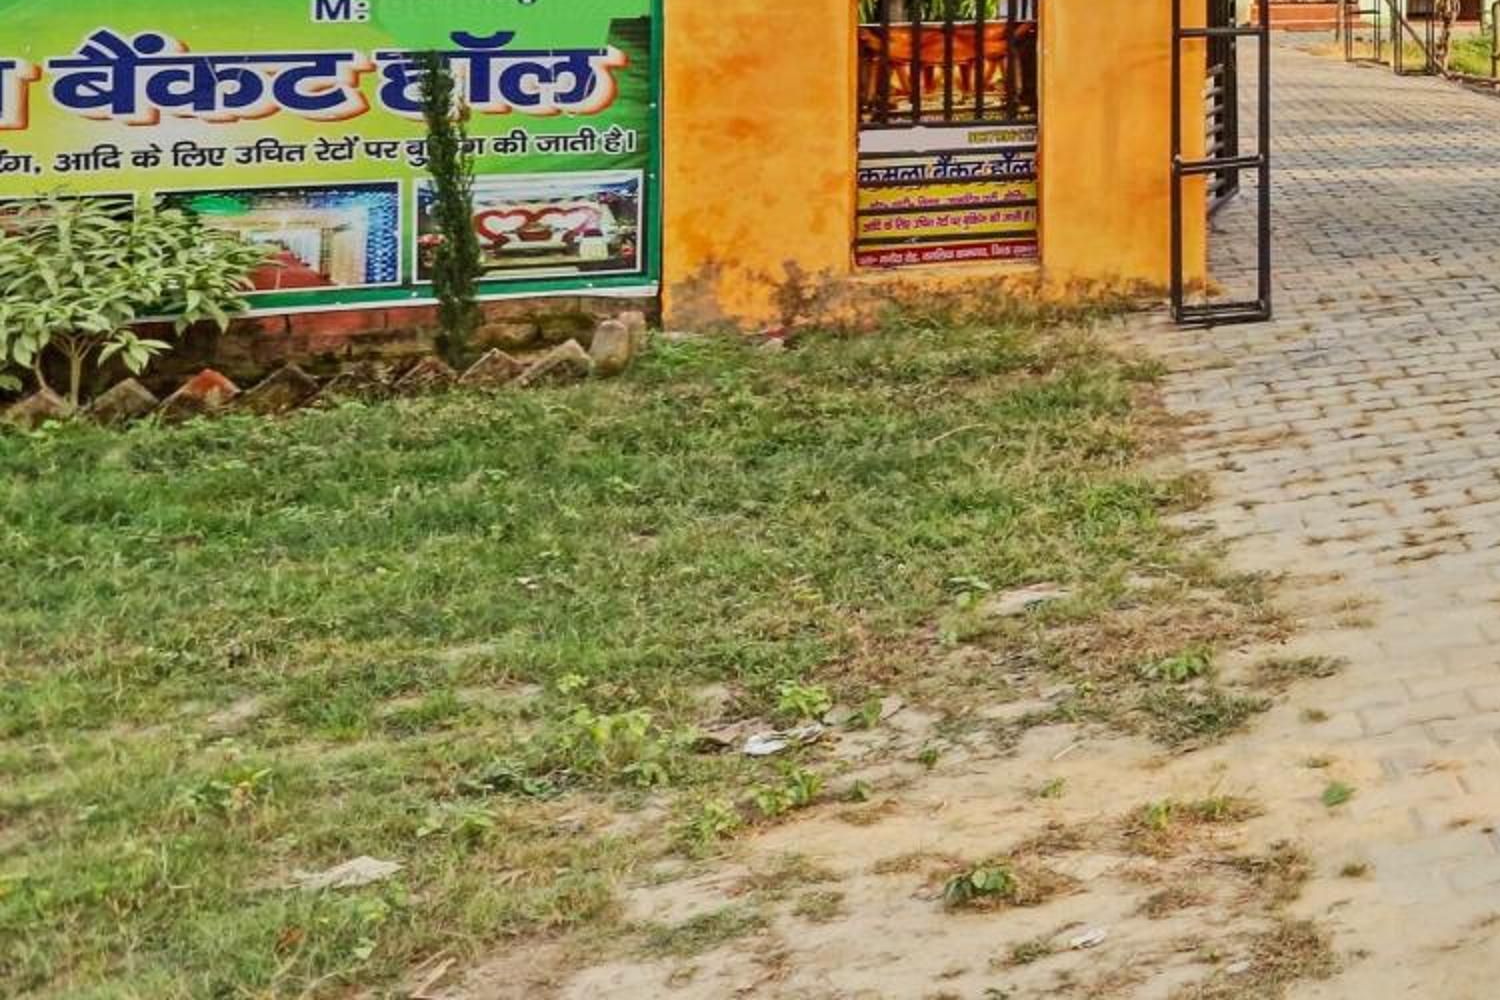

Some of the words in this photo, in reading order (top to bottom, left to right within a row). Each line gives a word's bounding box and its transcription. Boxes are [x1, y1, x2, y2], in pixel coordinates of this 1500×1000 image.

[48, 29, 356, 115] बैंकट
[375, 30, 609, 112] हॉल
[53, 143, 123, 172] आदि
[131, 145, 162, 168] के
[173, 141, 227, 168] लिए
[235, 136, 307, 166] उचित
[315, 135, 356, 161] रेटों
[364, 142, 399, 159] पर
[493, 130, 527, 155] की
[536, 127, 597, 154] जाती
